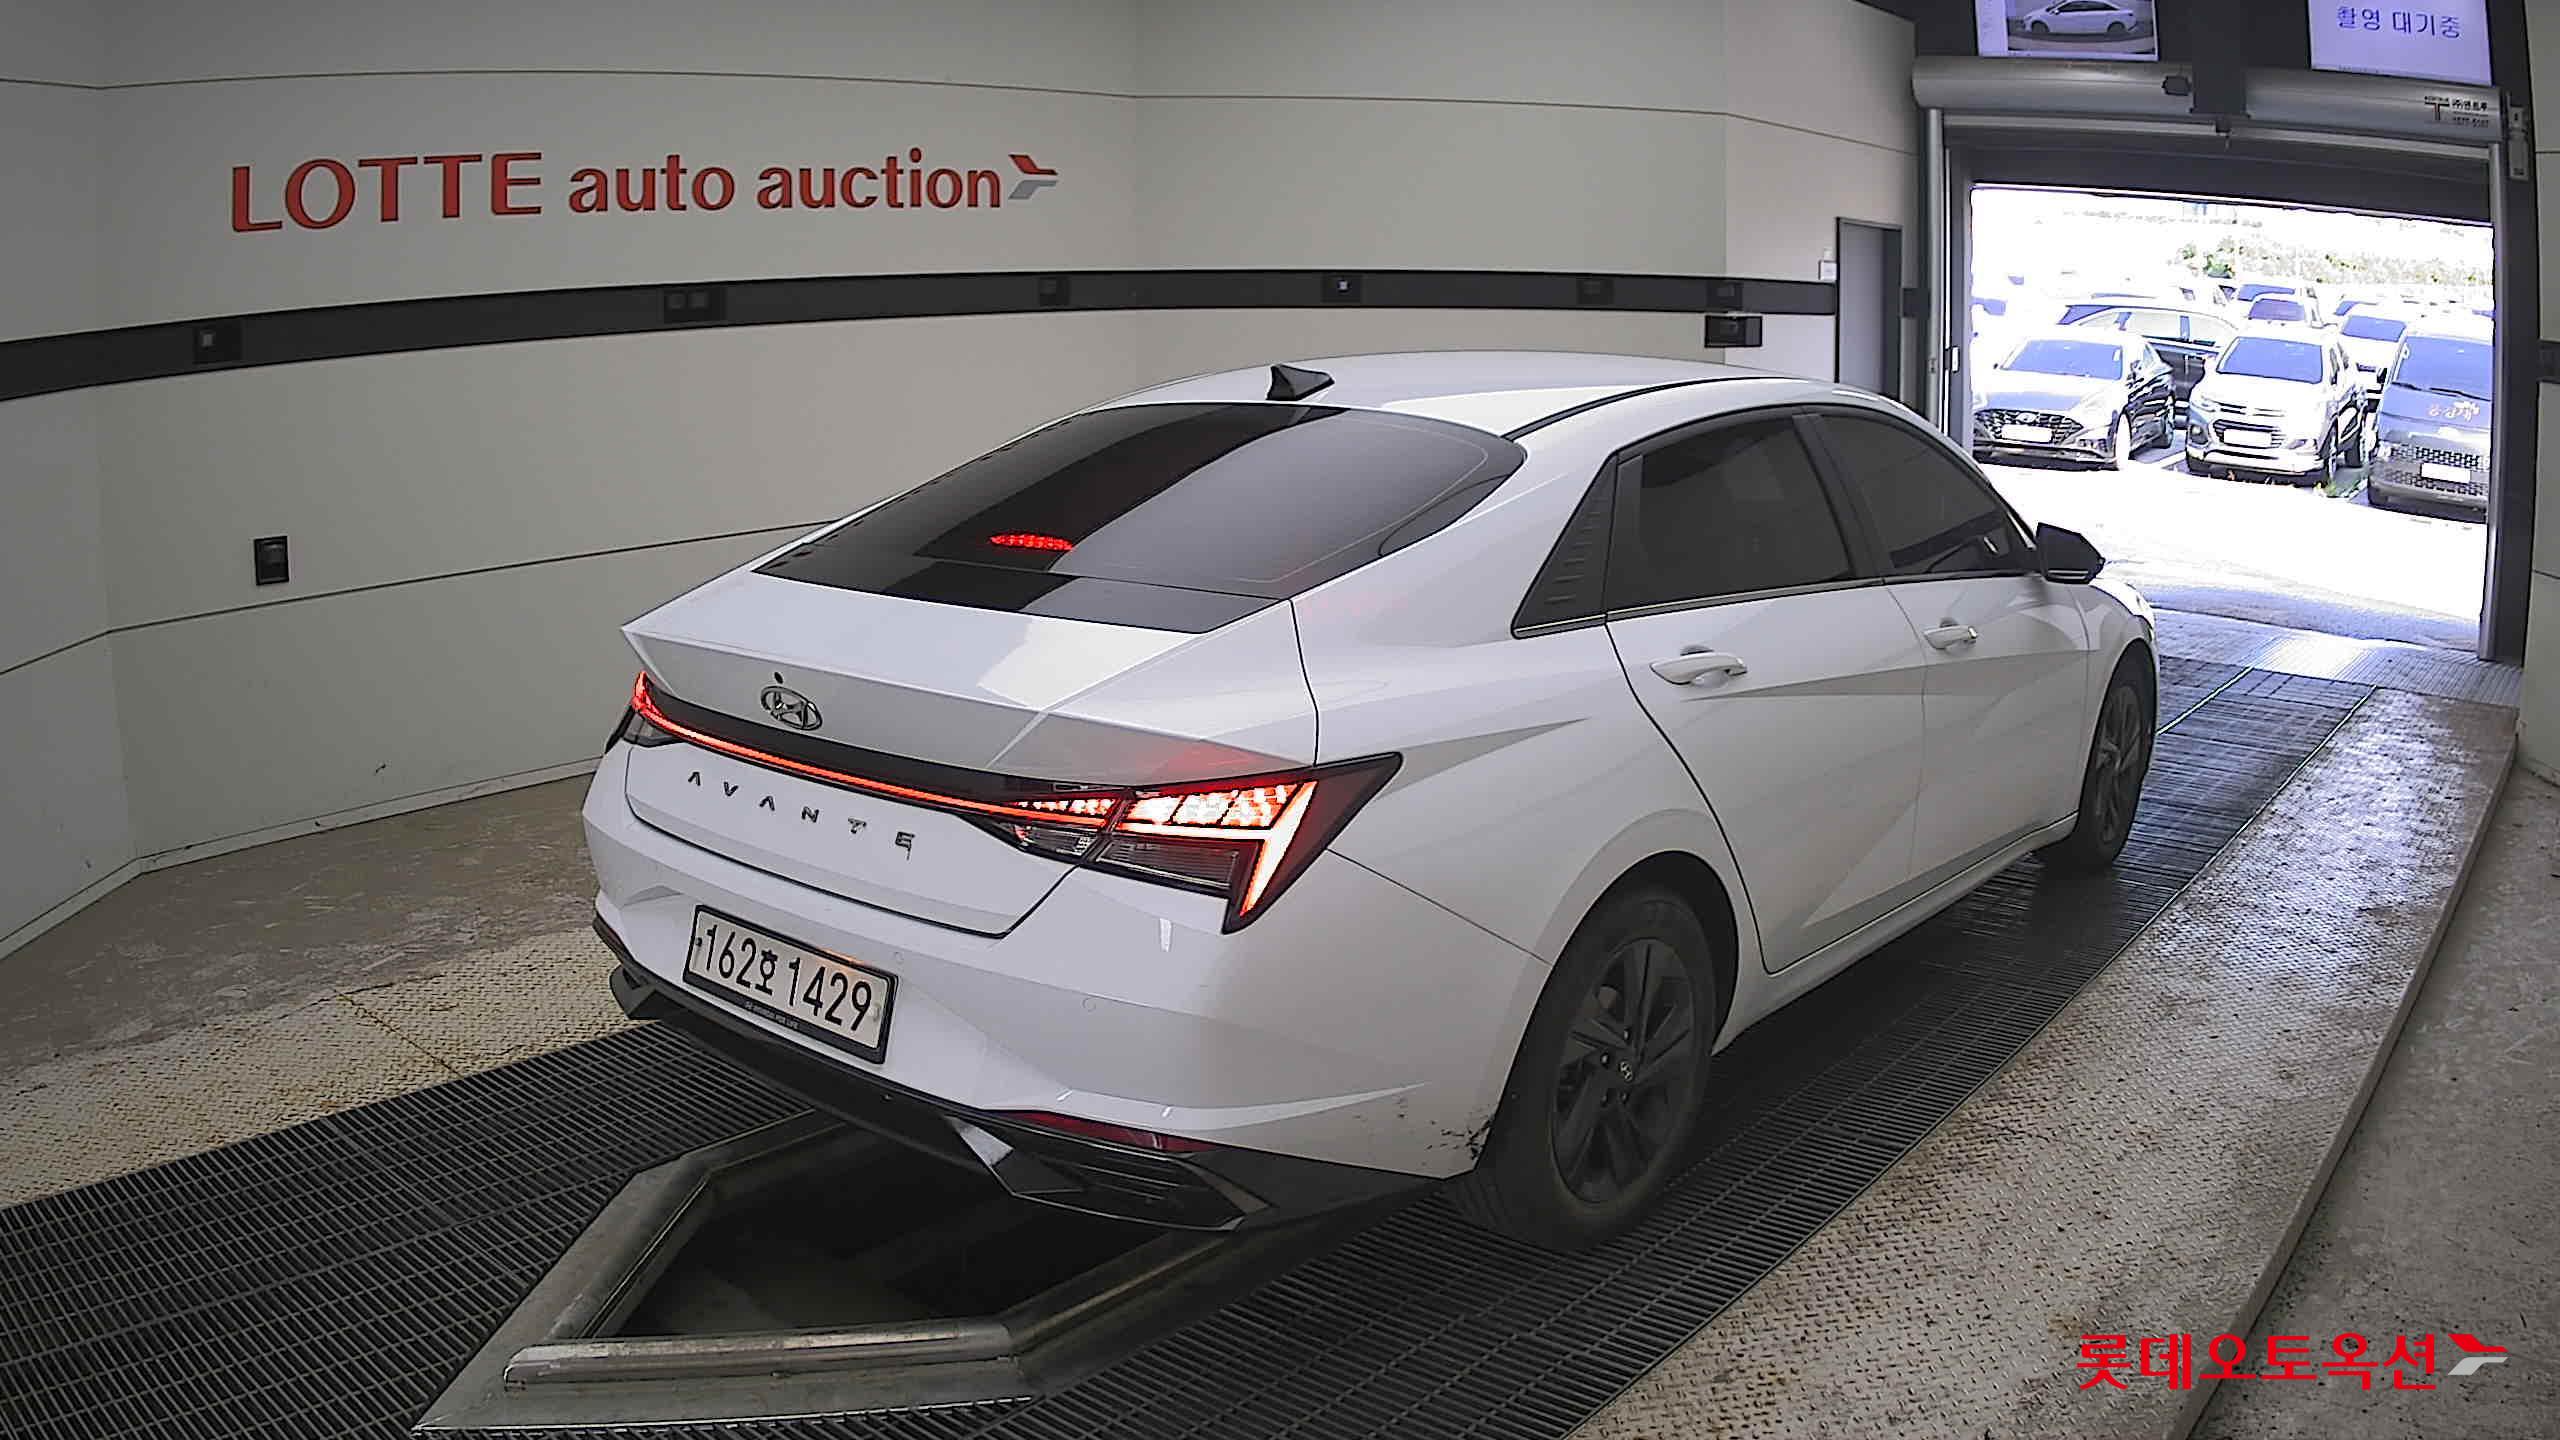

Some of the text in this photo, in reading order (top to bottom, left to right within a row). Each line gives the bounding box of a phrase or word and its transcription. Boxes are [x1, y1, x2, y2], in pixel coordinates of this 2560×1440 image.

[2337, 6, 2460, 39] 촬영 대기중
[231, 147, 1001, 233] LOTTE auto auction
[687, 770, 915, 850] AVANTE
[706, 924, 779, 996] 162호
[789, 956, 872, 1032] 1429
